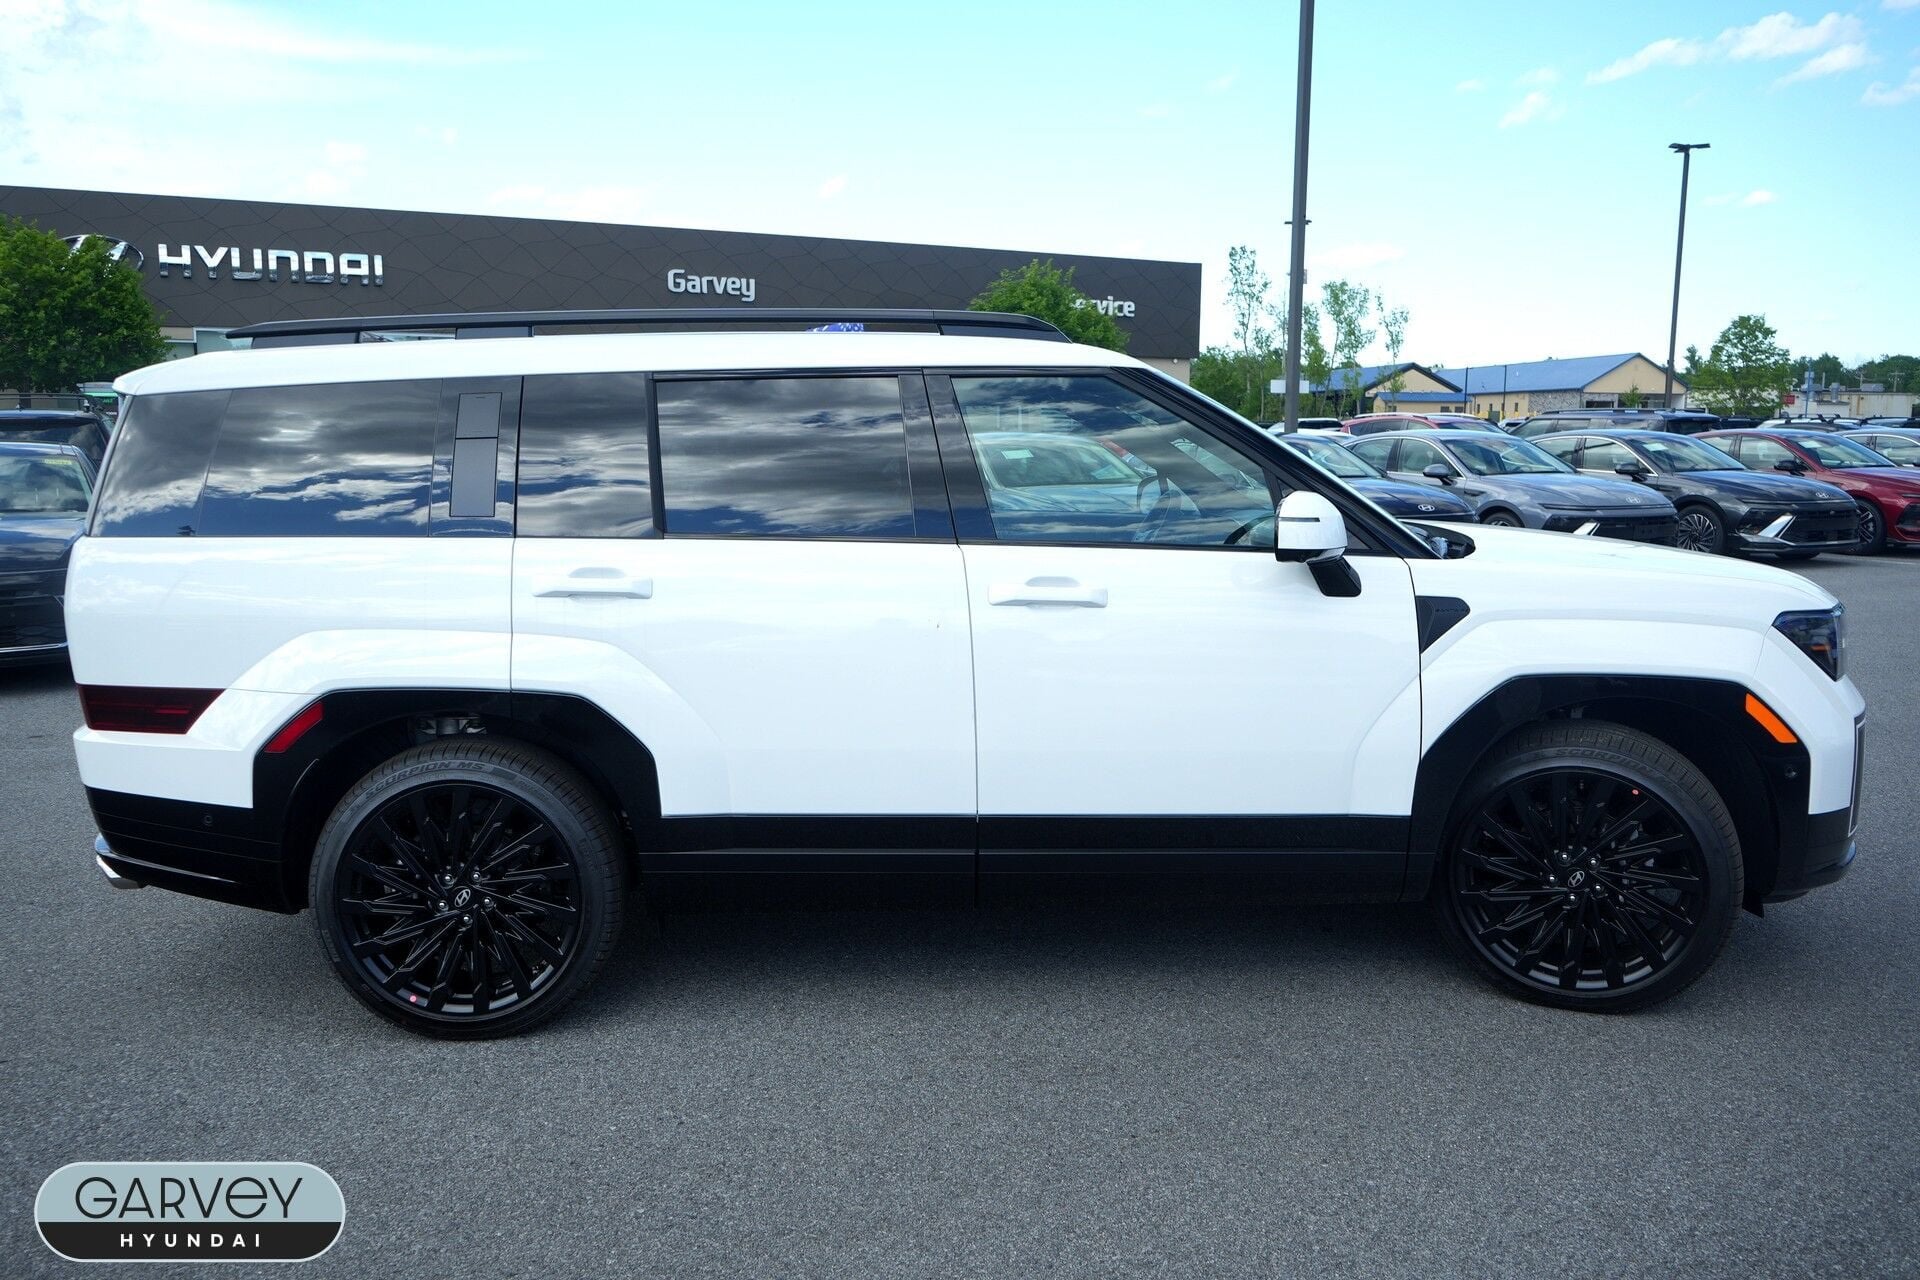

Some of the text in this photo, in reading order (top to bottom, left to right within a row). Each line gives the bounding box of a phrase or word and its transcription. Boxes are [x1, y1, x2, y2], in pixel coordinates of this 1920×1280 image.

[158, 244, 384, 286] HYUNDAI
[667, 268, 756, 302] Garvey
[1069, 295, 1136, 317] evice
[365, 761, 486, 800] SCORPION MS
